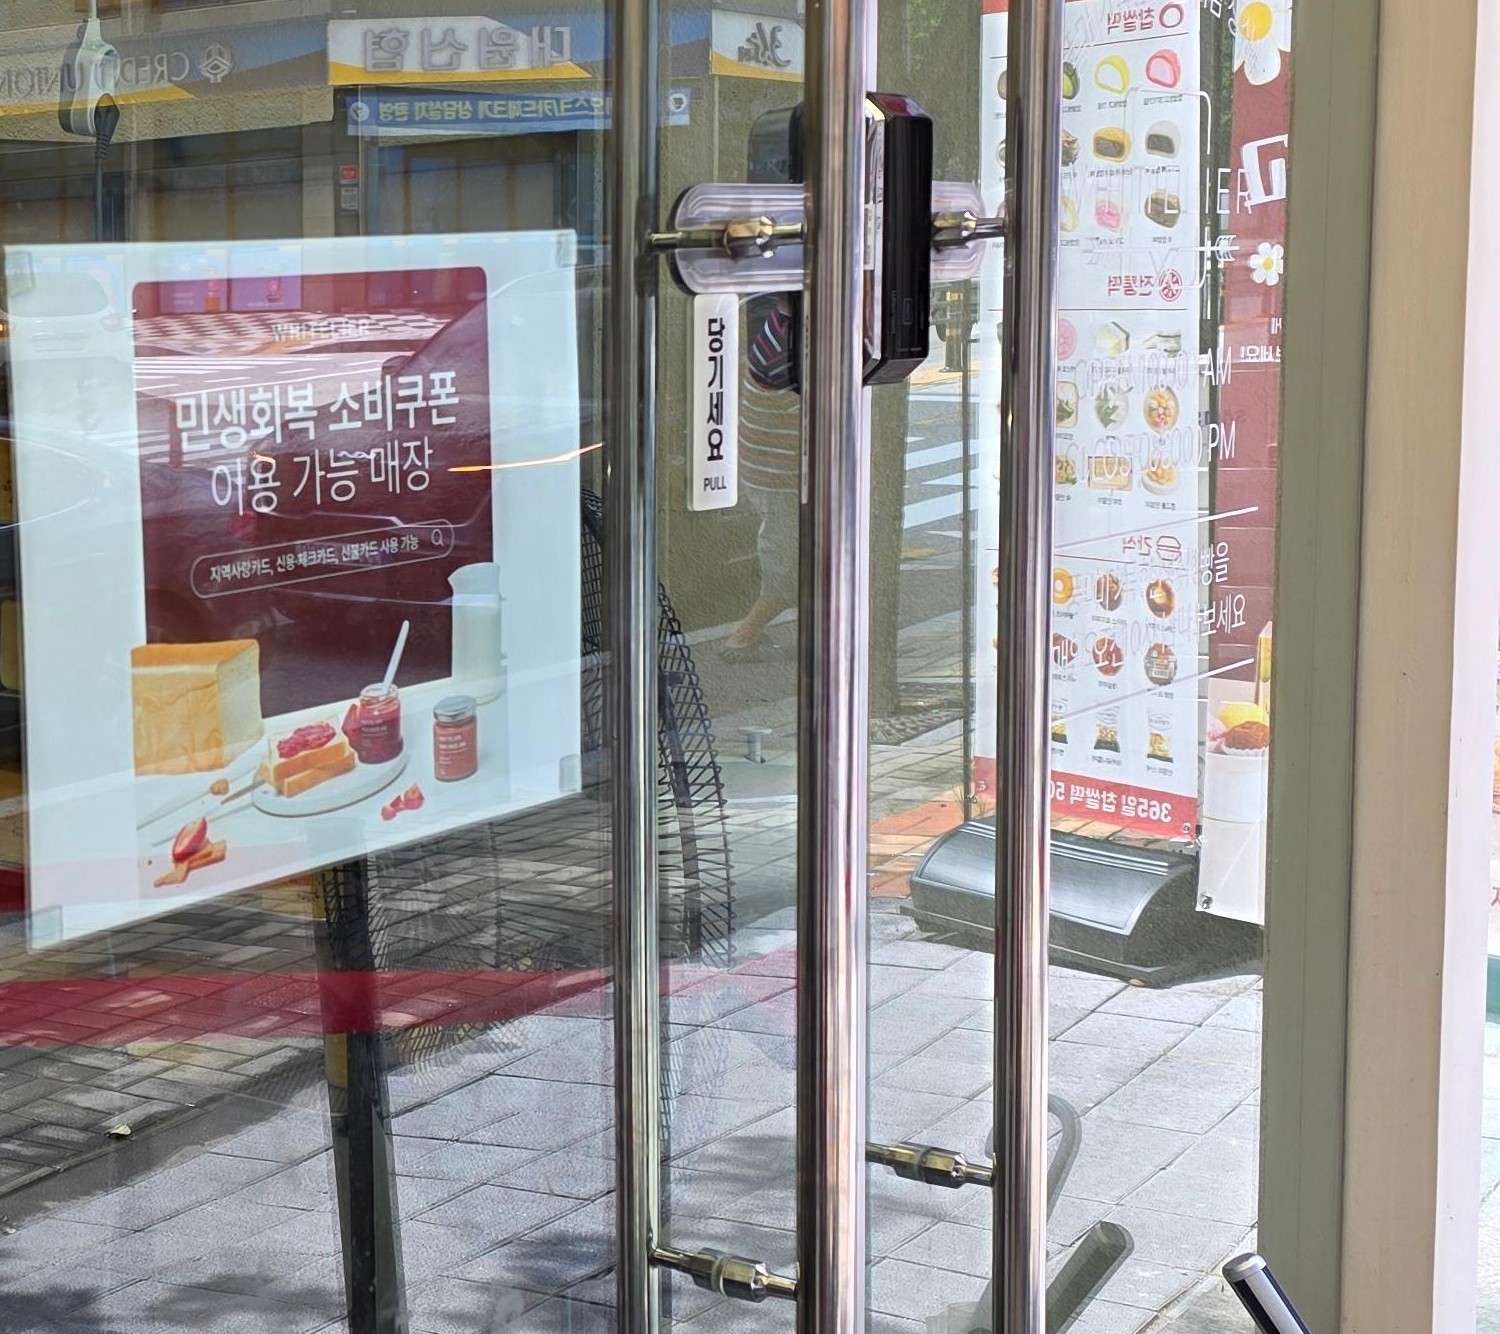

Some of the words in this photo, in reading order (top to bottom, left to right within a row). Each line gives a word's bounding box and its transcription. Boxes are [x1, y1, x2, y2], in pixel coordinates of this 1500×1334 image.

[174, 381, 319, 454] 민생회복
[328, 369, 460, 433] 소비쿠폰
[706, 316, 727, 463] 당기세요
[211, 452, 281, 517] 이용
[292, 447, 360, 506] 가능
[370, 434, 434, 495] 매장
[703, 475, 727, 492] PULL
[400, 533, 420, 551] 가능
